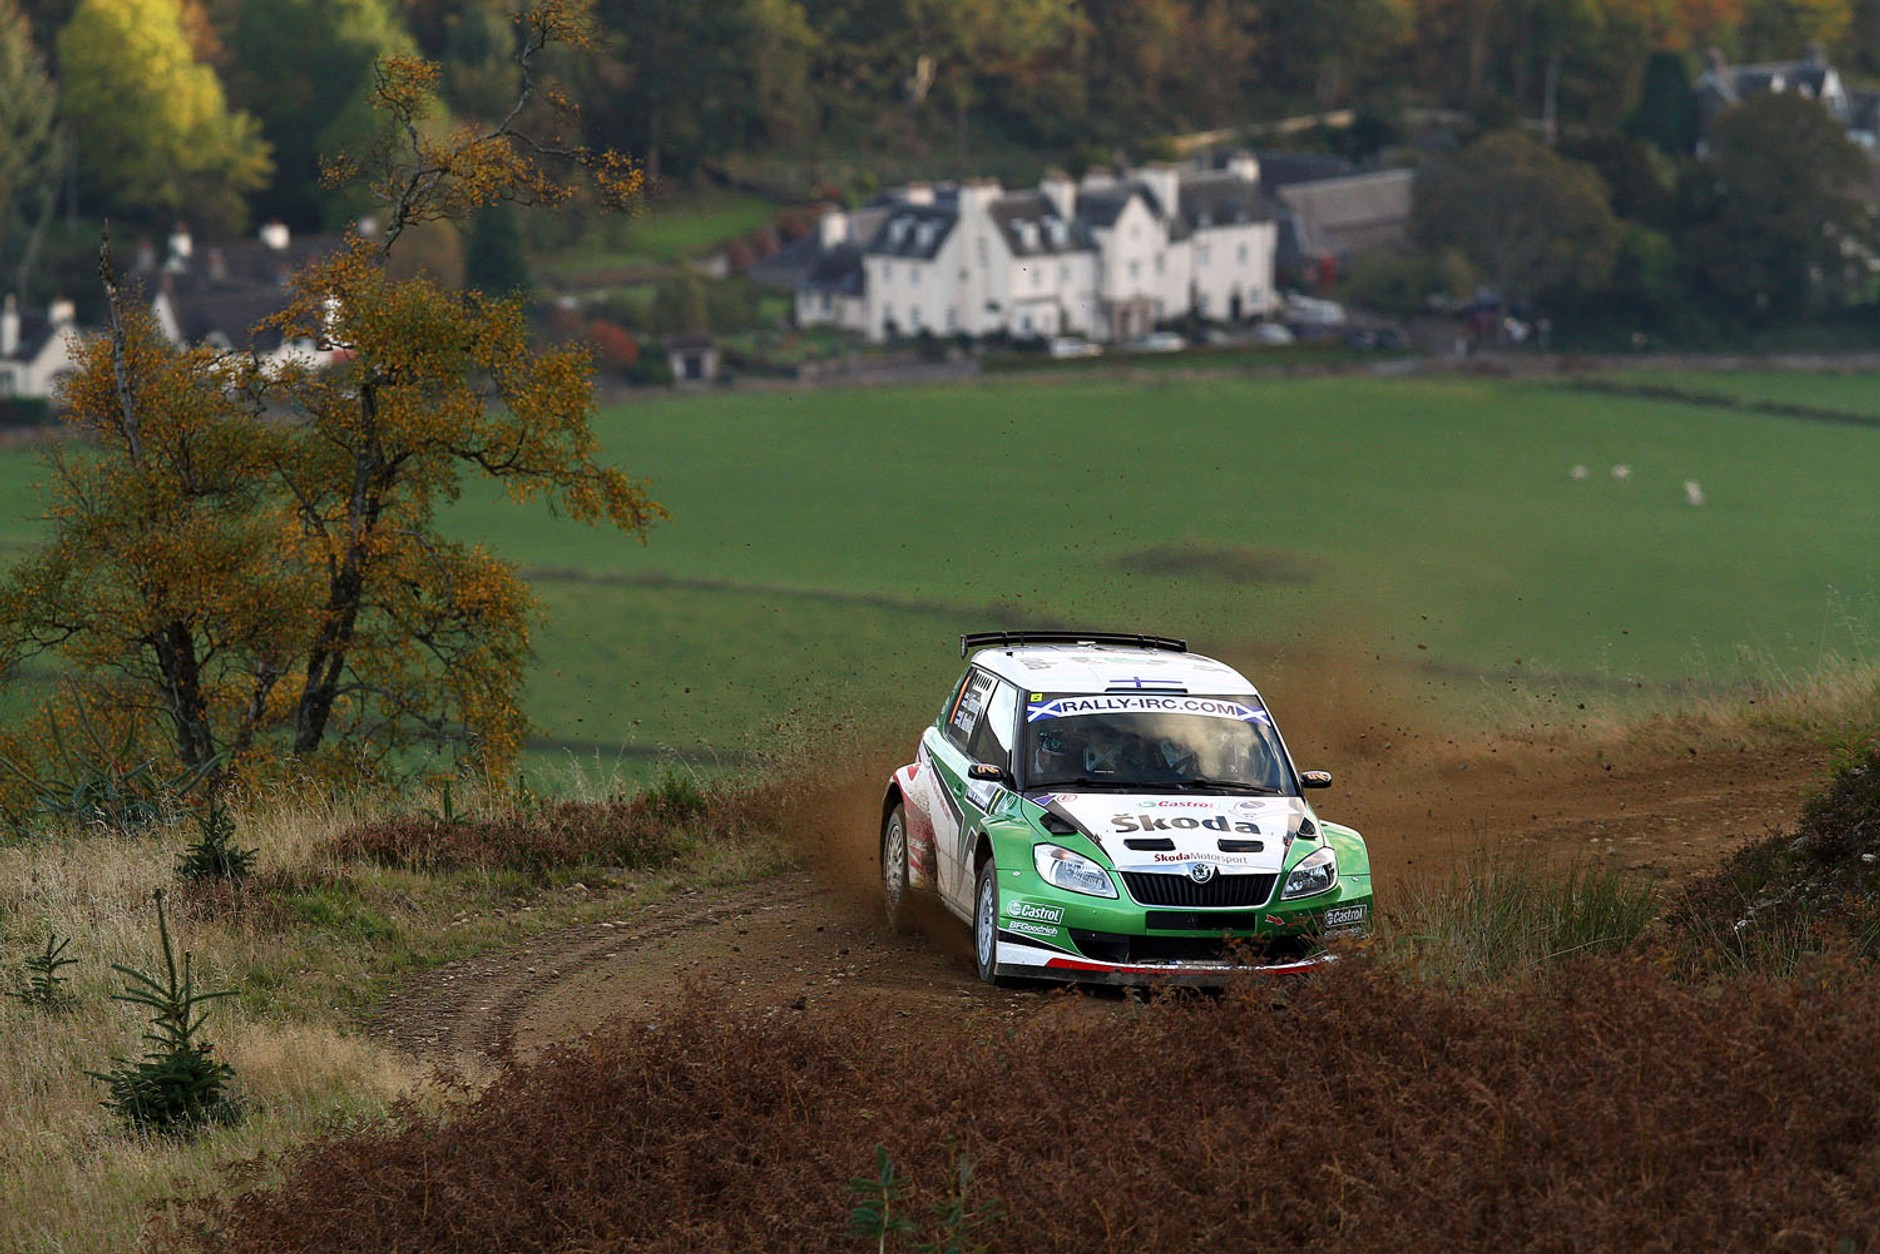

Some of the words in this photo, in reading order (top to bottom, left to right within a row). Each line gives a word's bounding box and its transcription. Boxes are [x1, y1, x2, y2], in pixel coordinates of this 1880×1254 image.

[1062, 698, 1236, 716] RALLY-IRC.COM
[1021, 905, 1060, 921] Castrol
[1333, 908, 1363, 923] Castrol
